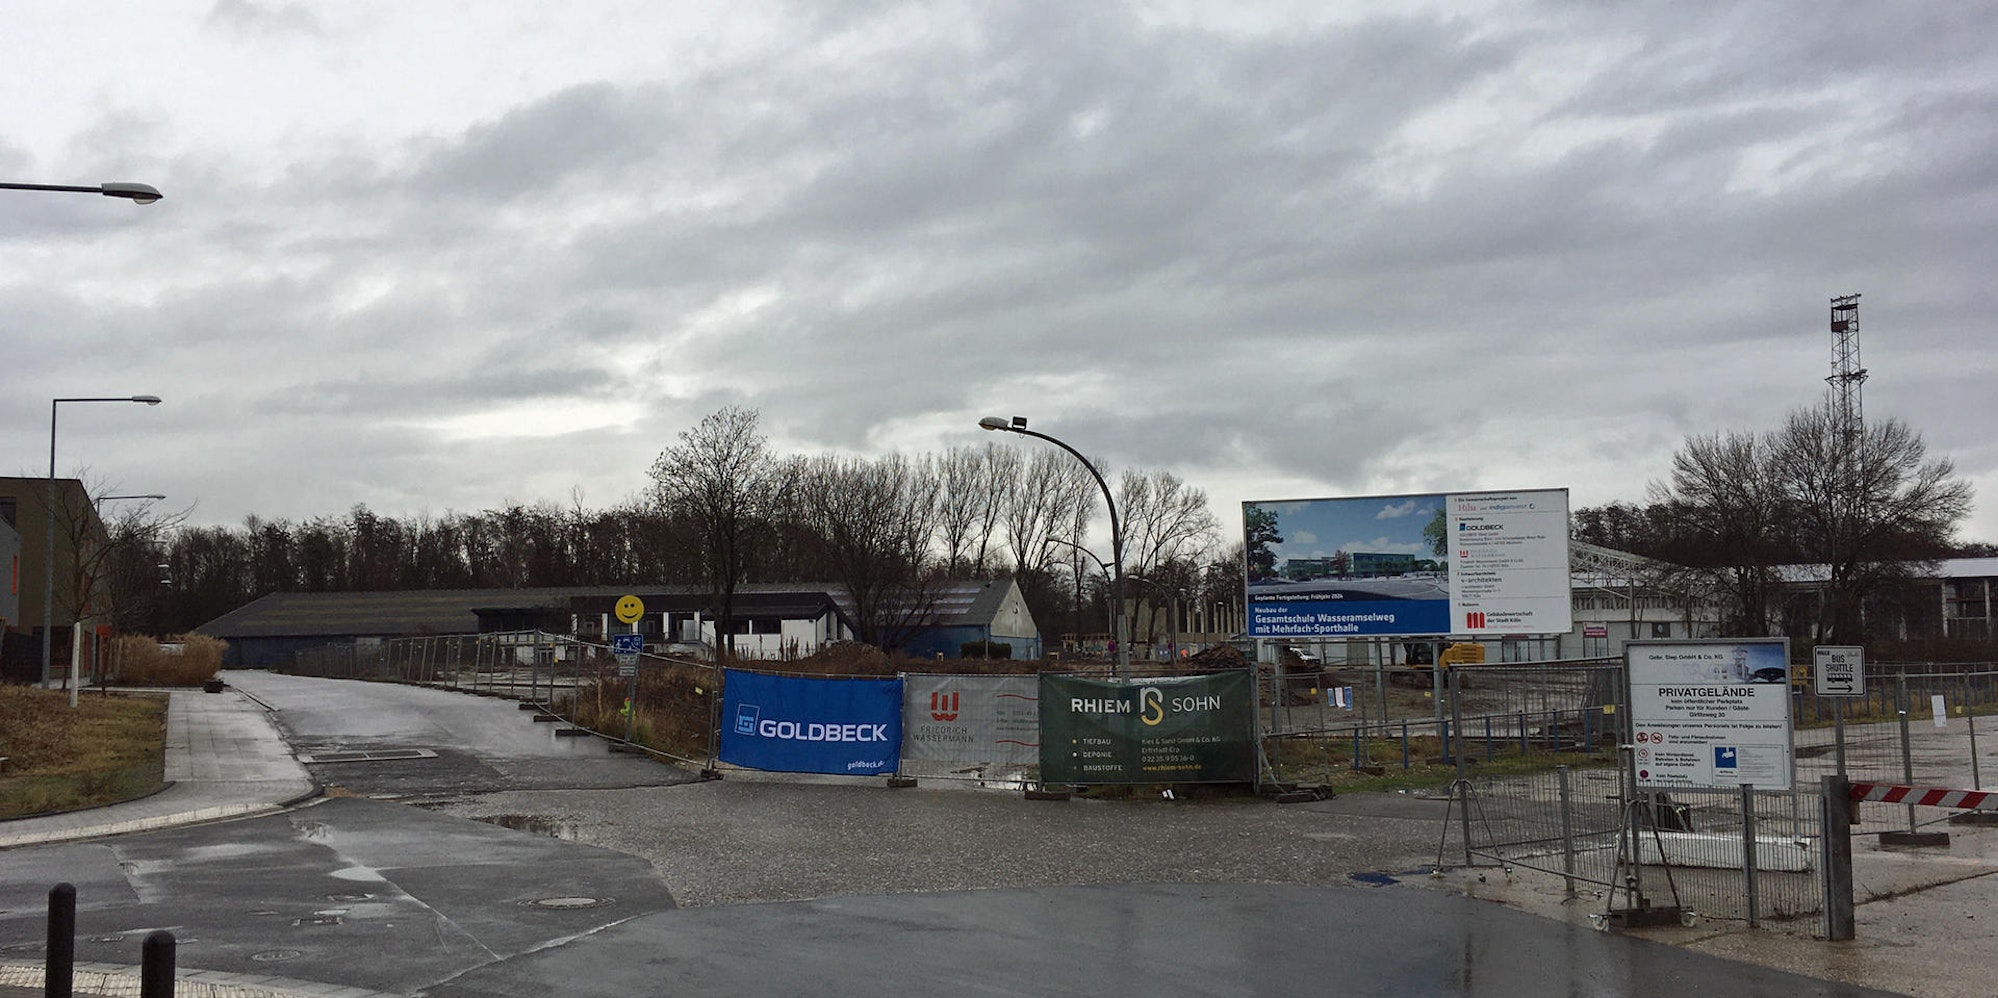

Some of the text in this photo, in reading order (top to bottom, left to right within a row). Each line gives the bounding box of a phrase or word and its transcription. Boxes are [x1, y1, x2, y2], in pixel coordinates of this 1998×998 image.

[1255, 613, 1395, 624] Gesamtschule Wasseramselweg
[1255, 623, 1359, 634] mit Mehrfach-Sporthalle
[1831, 654, 1845, 663] BUS
[1825, 663, 1854, 672] SHUTTLE
[1658, 686, 1755, 697] PRIVATGELÄNDE
[1071, 695, 1221, 714] RHIEM SOHN
[759, 719, 888, 742] GOLDBECK
[920, 725, 968, 734] FRIEDRICH
[913, 734, 975, 743] WASSERMANN
[1083, 764, 1123, 772] BAUSTOFFE
